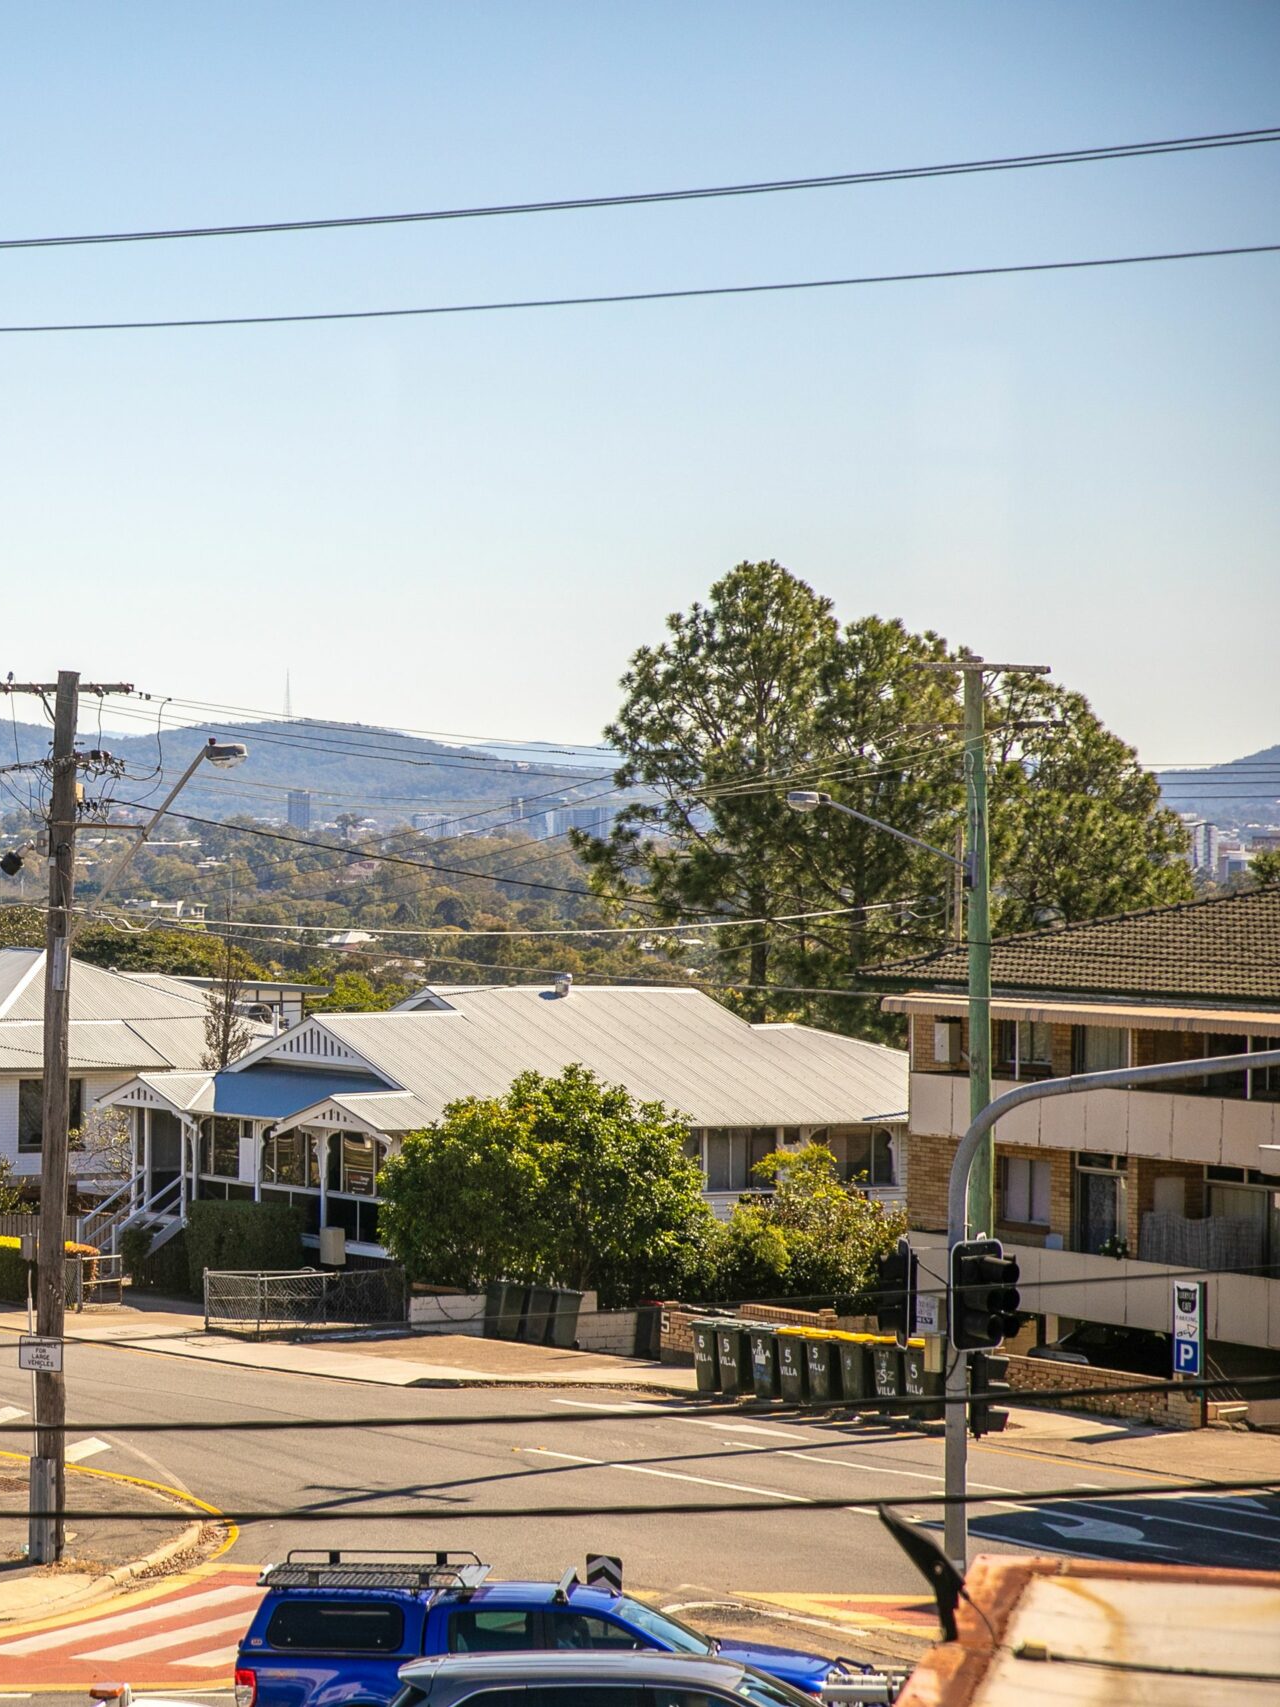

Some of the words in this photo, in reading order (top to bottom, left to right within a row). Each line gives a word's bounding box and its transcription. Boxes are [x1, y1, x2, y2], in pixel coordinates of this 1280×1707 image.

[661, 1312, 670, 1333] 5
[698, 1335, 705, 1348] 5
[723, 1338, 730, 1352] 5
[695, 1353, 712, 1362] VILLA
[720, 1355, 737, 1367] VILLA
[785, 1349, 792, 1363] 5
[1180, 1343, 1193, 1367] P
[780, 1366, 798, 1376] VILLA
[911, 1363, 918, 1378] 5
[877, 1386, 896, 1395] VILLA
